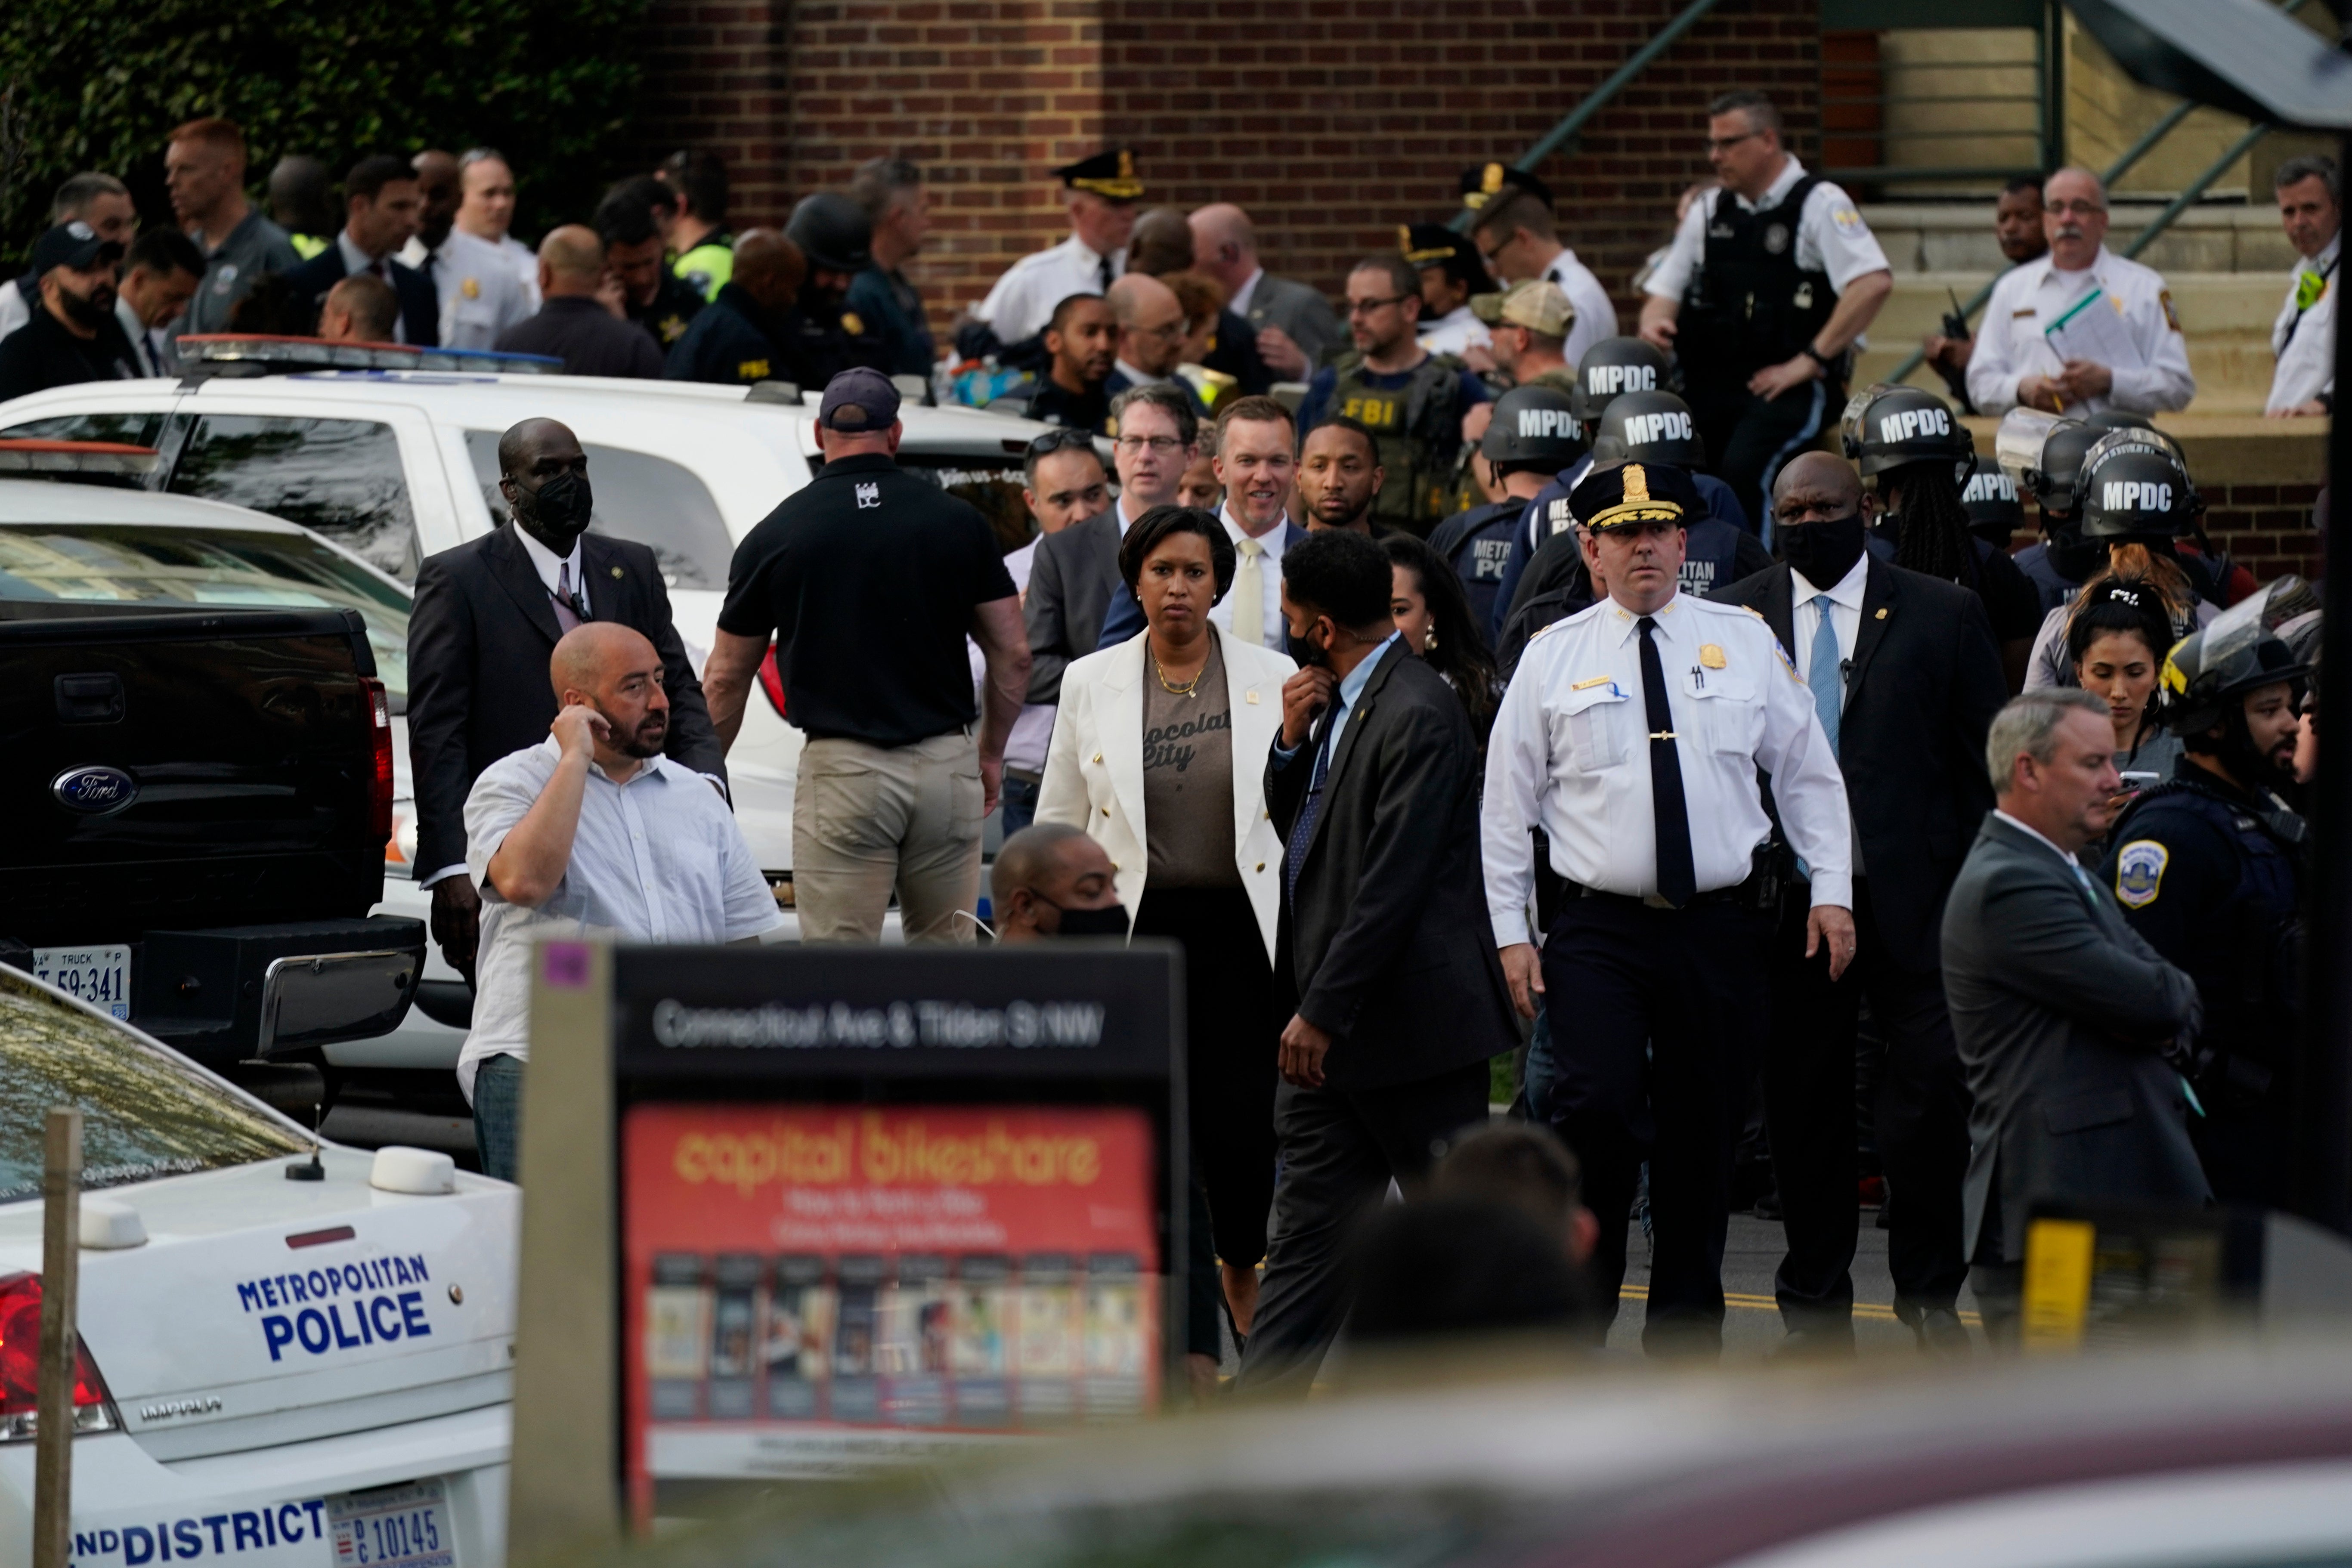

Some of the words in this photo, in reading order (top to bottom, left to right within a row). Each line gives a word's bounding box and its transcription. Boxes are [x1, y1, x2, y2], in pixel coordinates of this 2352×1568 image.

[1588, 365, 1656, 395] MPDC
[1345, 398, 1394, 425] FBI
[1624, 412, 1692, 446] MPDC
[1880, 408, 1950, 444] MPDC
[2103, 481, 2172, 513] MPDC
[1143, 708, 1231, 745] ocolat
[77, 775, 119, 800] Ford
[62, 953, 92, 965] TRUCK
[115, 953, 121, 962] P
[828, 1000, 888, 1048] Ave
[675, 1123, 851, 1200] capital
[863, 1116, 1100, 1186] bikeshare
[236, 1254, 429, 1312] METROPOLITAN
[261, 1291, 431, 1362] POLICE
[123, 1500, 324, 1566] DISTRICT
[373, 1509, 439, 1560] 10145
